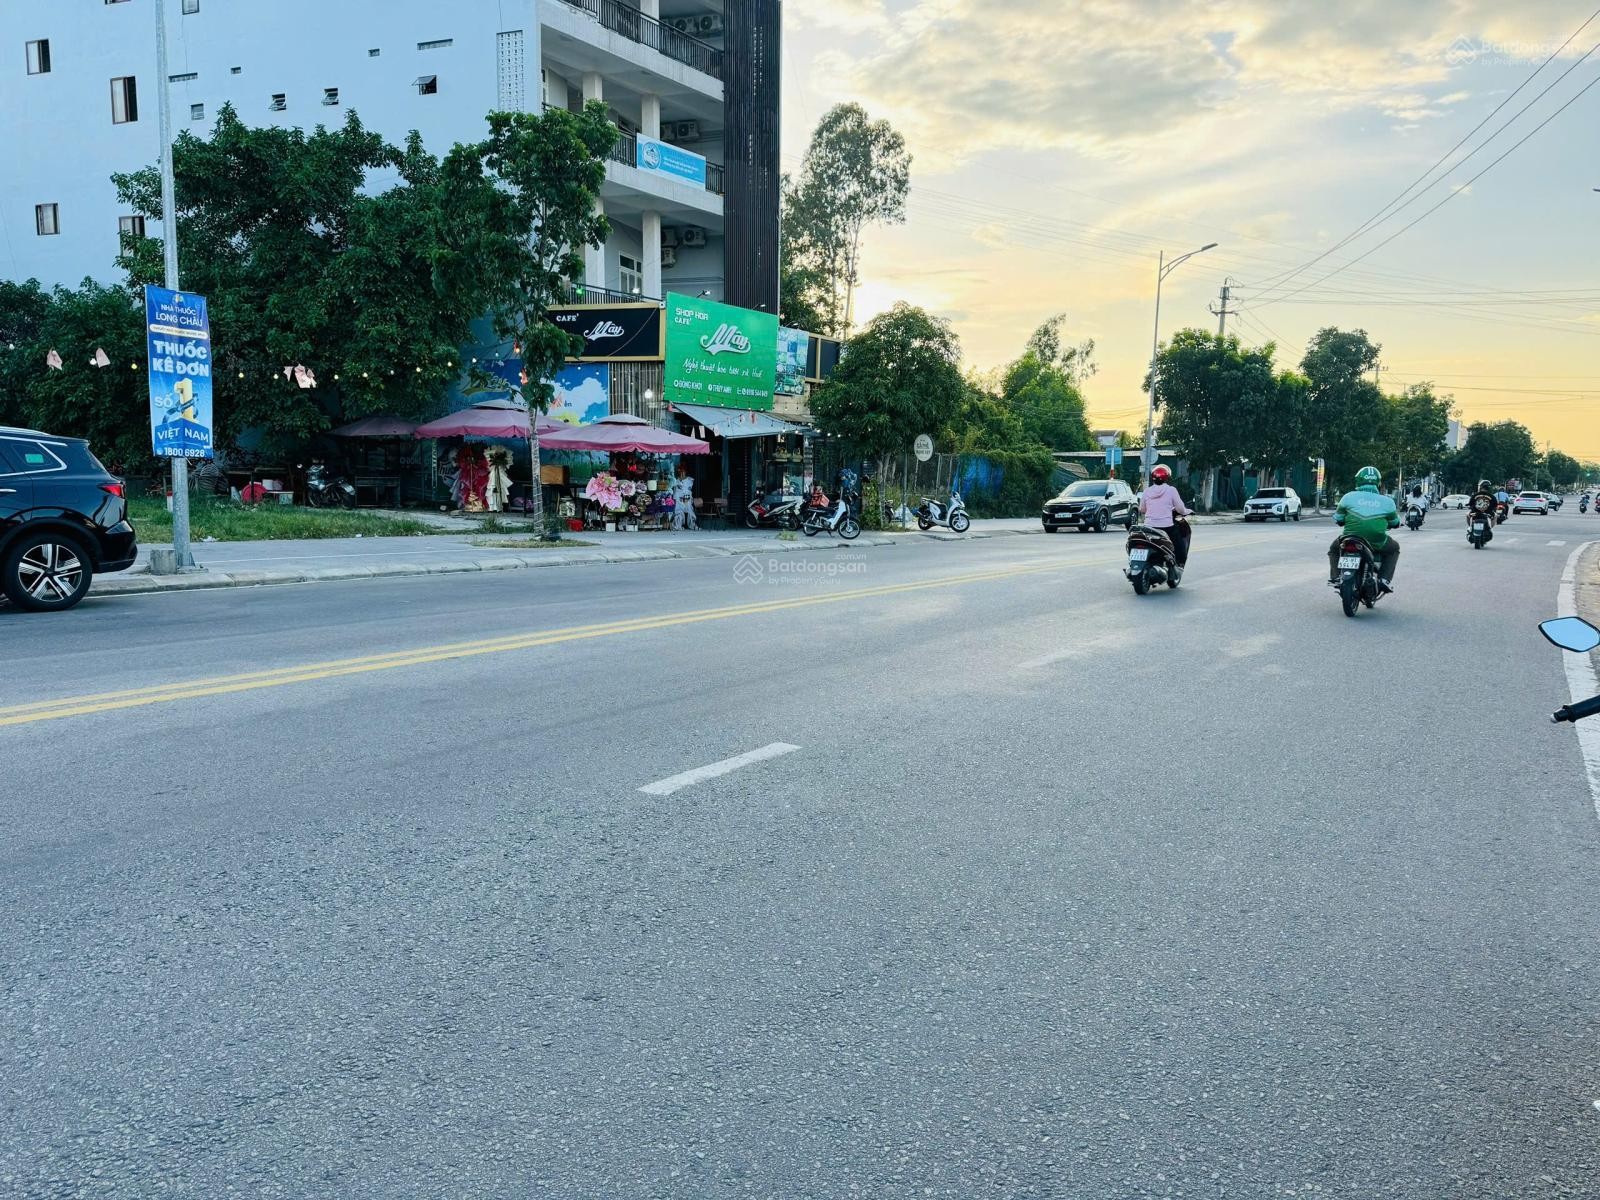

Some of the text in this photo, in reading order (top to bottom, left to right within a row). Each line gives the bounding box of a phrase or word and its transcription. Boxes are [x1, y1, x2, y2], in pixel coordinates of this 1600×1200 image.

[175, 305, 197, 316] THUỐC
[675, 307, 709, 321] SHOP HOA
[155, 311, 203, 327] LONG CHÂU
[583, 320, 625, 341] Mây
[700, 323, 751, 356] Mây
[153, 340, 208, 360] THUỐC
[152, 356, 210, 377] KÊ ĐƠN
[154, 392, 174, 409] SỐ
[157, 427, 209, 442] VIỆT NAM
[164, 447, 205, 458] 1800 6928
[1357, 497, 1381, 508] Grab
